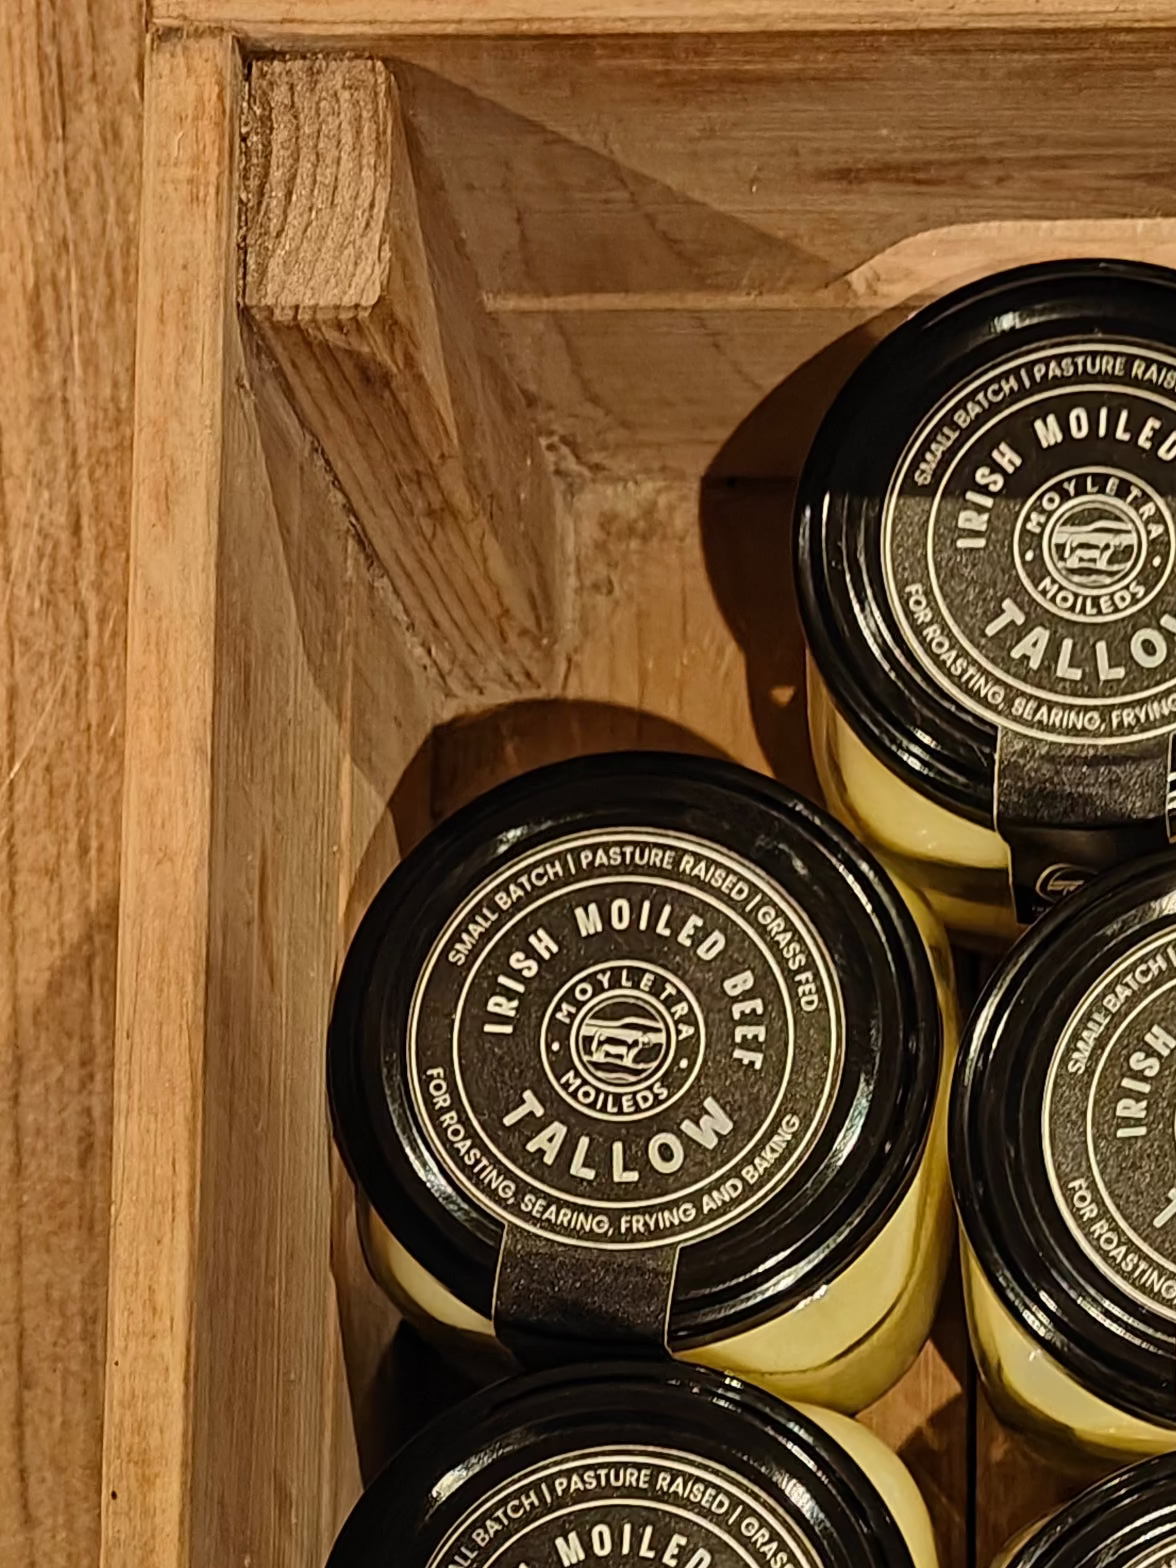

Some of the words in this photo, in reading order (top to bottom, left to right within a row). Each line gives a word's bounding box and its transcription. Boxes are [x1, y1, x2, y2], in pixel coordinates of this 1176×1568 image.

[956, 443, 1021, 547] IRISH
[1026, 474, 1165, 540] MOYLETRA
[1037, 576, 1145, 614] MOILEDS
[447, 907, 499, 966] SMALL
[493, 860, 563, 910] BATCH
[579, 845, 675, 869] PASTURE
[678, 853, 749, 900] RAISED
[757, 905, 806, 970] GRASS
[794, 971, 819, 1012] FED
[483, 928, 558, 1034] IRISH
[574, 898, 726, 960] MOILED
[723, 970, 766, 1070] BEEF
[555, 968, 696, 1041] MOYLETRA
[560, 1070, 669, 1113] MOILEDS
[1116, 1025, 1176, 1137] IRISH
[426, 1067, 452, 1110] FOR
[620, 1201, 696, 1234] FRYING
[701, 1178, 742, 1215] AND
[740, 1114, 800, 1185] BAKING
[503, 1089, 733, 1182] TALLOW
[470, 1490, 538, 1547] BATCH
[554, 1466, 650, 1496] PASTURE
[655, 1470, 730, 1514] RAISED
